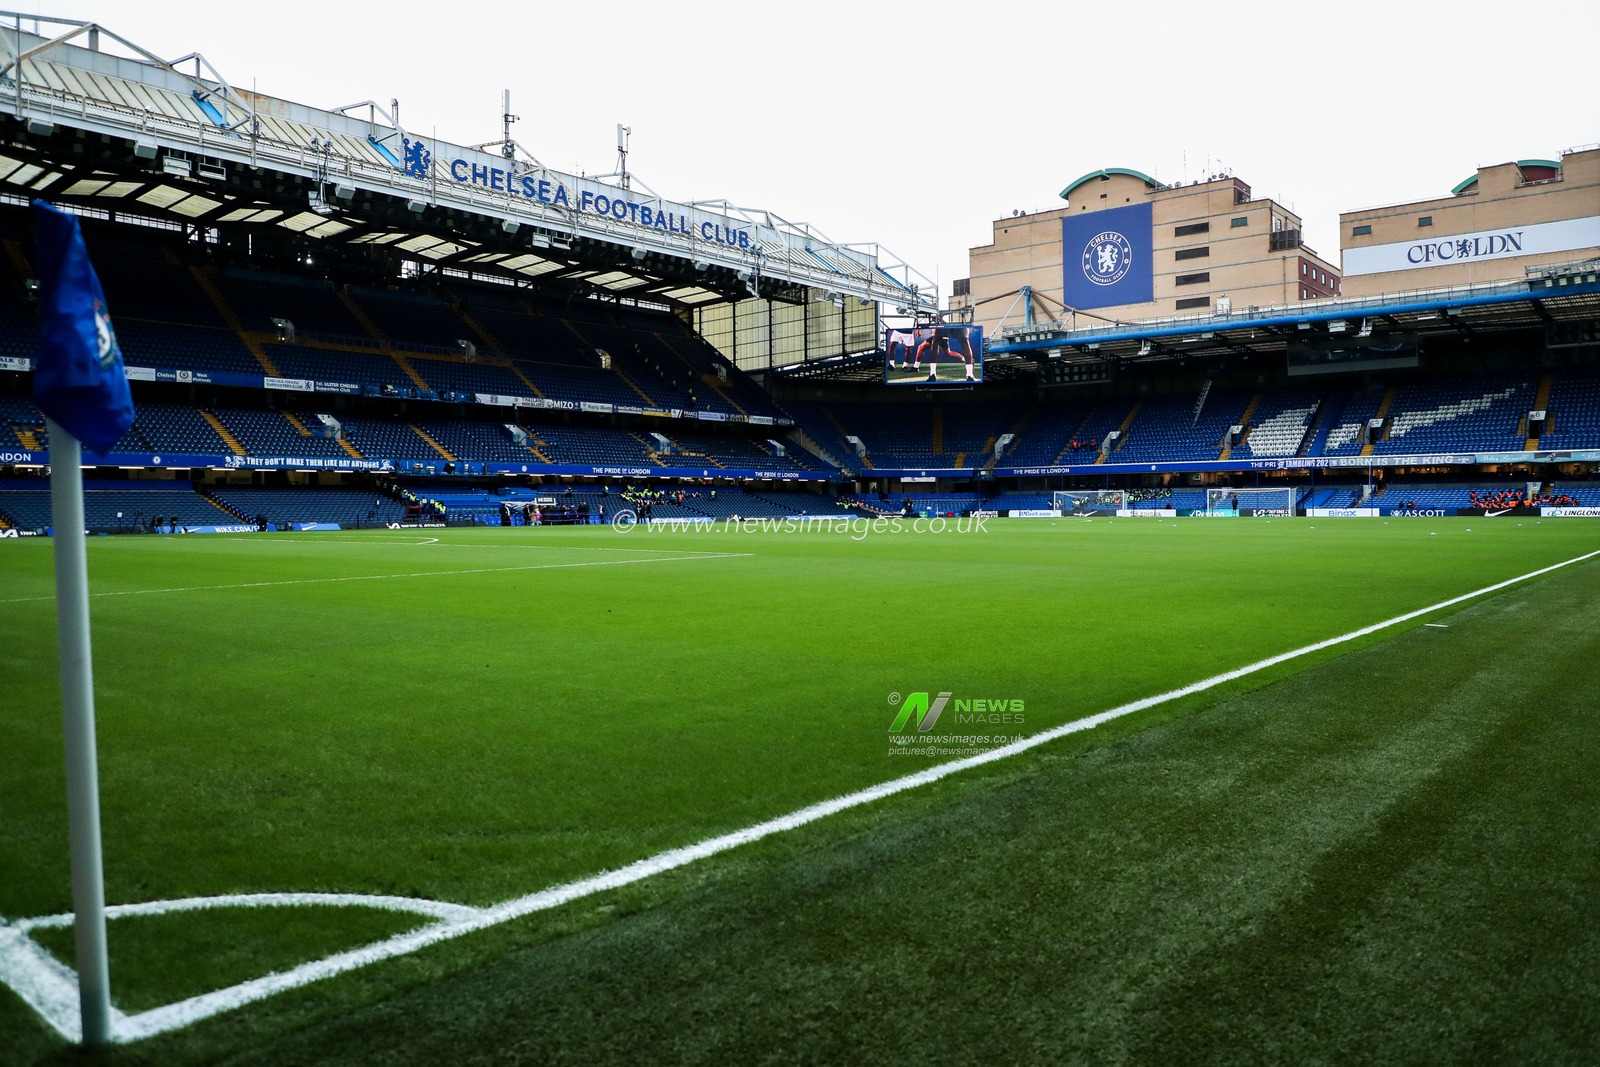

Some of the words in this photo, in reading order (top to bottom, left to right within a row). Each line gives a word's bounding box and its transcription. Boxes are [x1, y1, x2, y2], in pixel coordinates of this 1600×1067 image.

[451, 159, 569, 206] CHELSEA
[581, 191, 690, 235] FOOTBALL
[701, 221, 749, 248] CLUB
[1090, 233, 1123, 247] CHELSEA
[1407, 241, 1455, 264] CFC
[1473, 232, 1524, 256] LDN
[1090, 274, 1112, 283] FOOTBALL
[1112, 270, 1123, 280] CLUB
[553, 400, 574, 409] MIZO
[246, 457, 264, 466] THEY
[265, 458, 285, 466] DON'T
[286, 458, 304, 466] MAKE
[324, 459, 338, 467] LIKE
[351, 460, 380, 468] ANYMORE
[1316, 459, 1329, 467] 202
[1340, 458, 1373, 466] BORN
[1376, 457, 1388, 465] IS
[1394, 456, 1418, 465] THE
[1423, 455, 1454, 464] KING
[1404, 509, 1445, 517] ASCOTT
